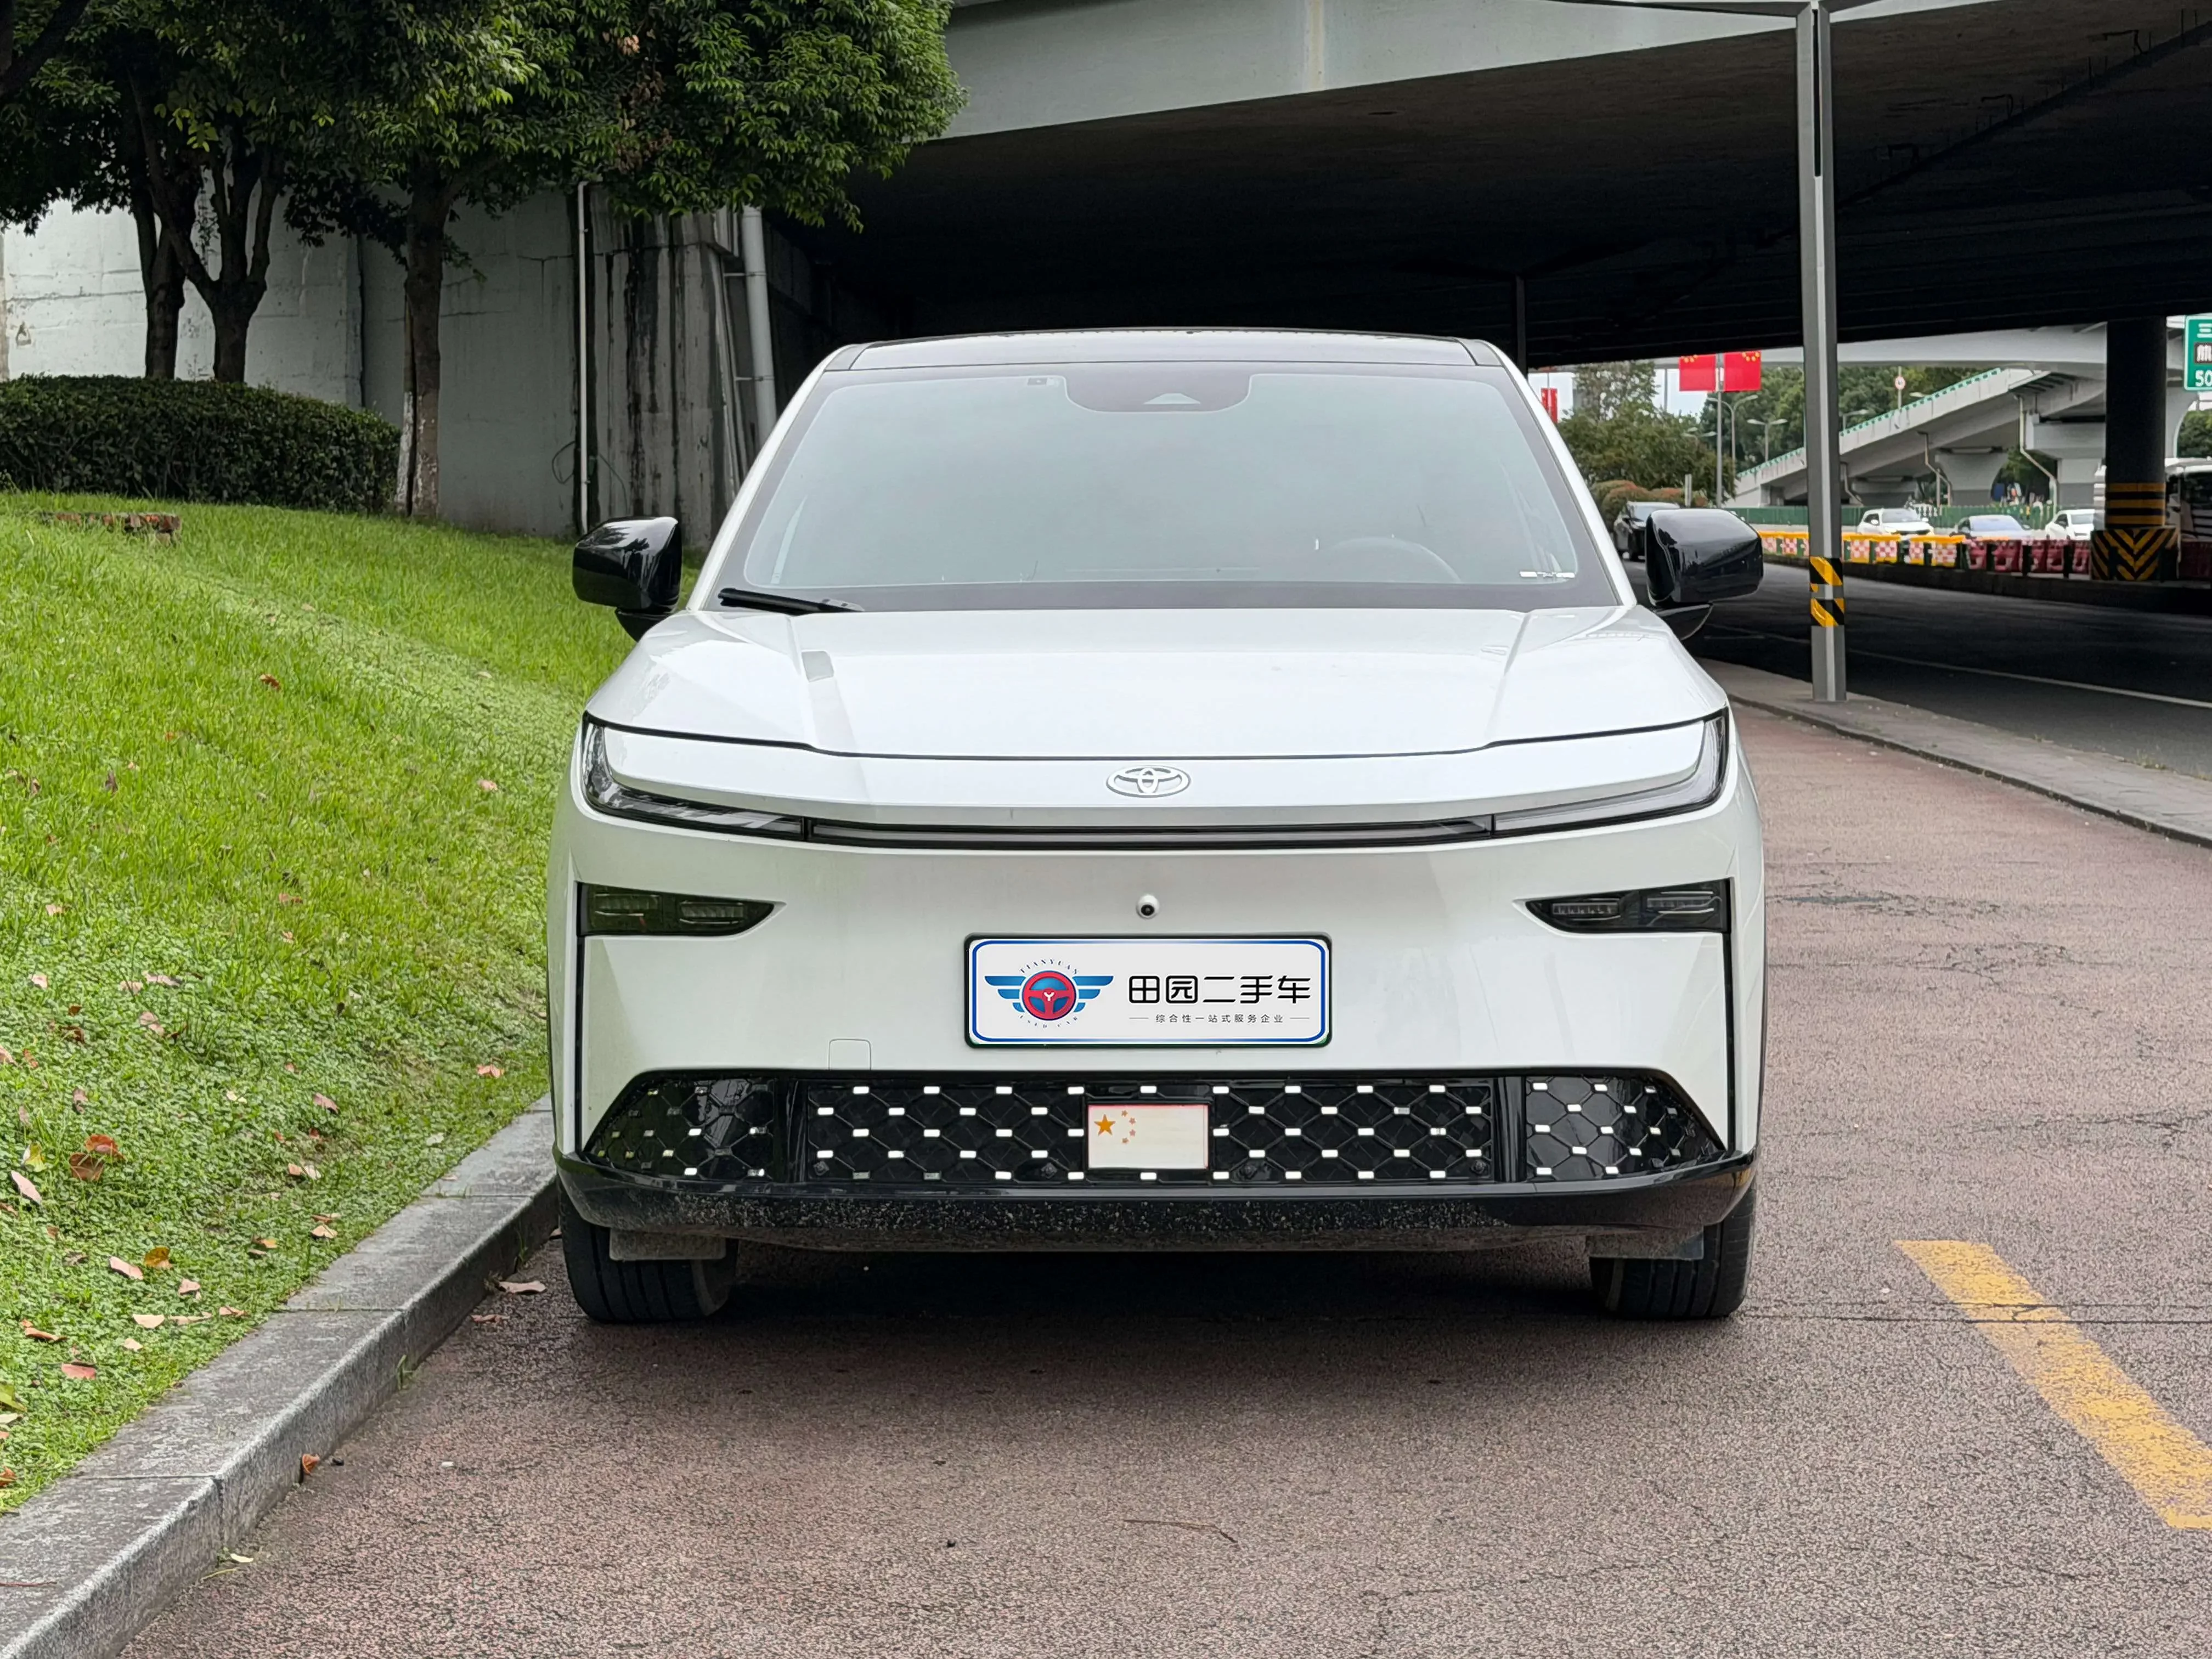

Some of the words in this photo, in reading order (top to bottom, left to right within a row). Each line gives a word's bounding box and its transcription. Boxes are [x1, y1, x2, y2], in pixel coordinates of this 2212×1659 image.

[1129, 975, 1311, 1003] 田园二手车
[1155, 1014, 1283, 1023] 综合性一站式服务企业
